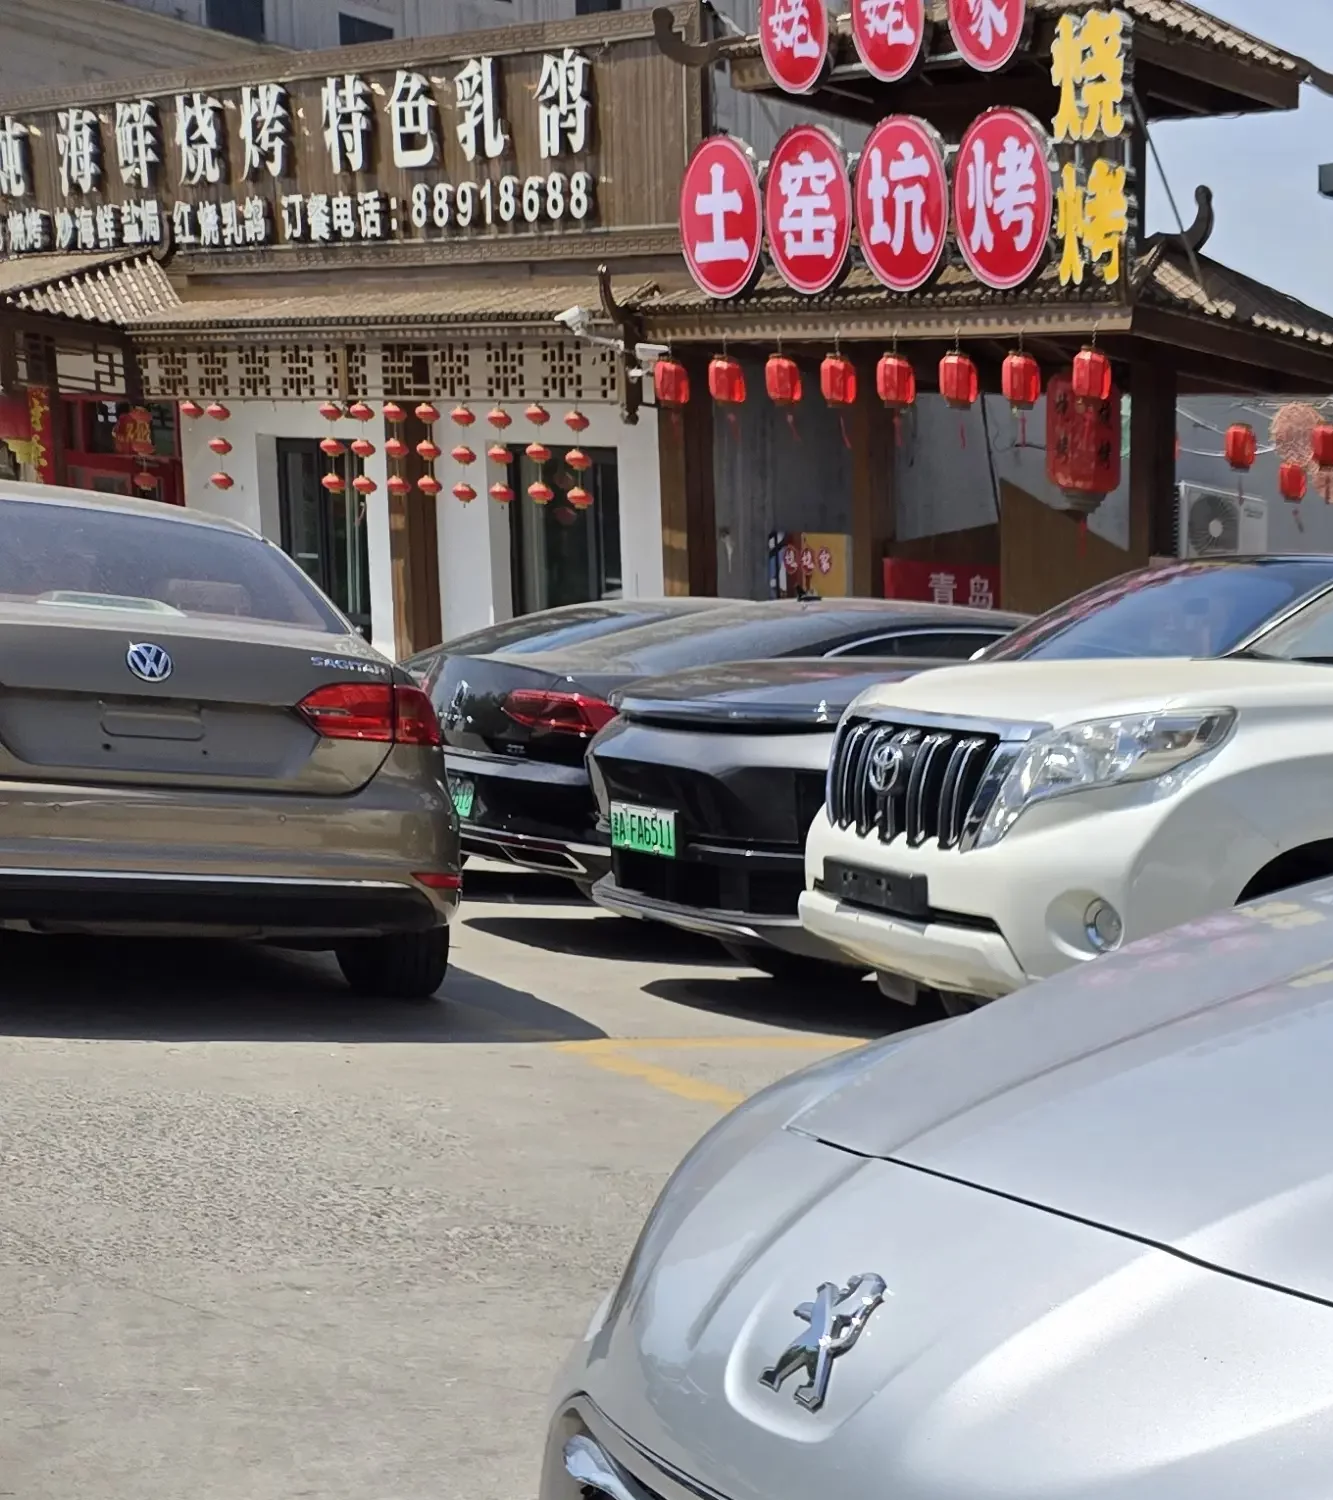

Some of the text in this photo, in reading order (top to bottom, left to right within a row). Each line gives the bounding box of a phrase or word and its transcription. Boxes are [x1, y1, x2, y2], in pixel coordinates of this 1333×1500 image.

[57, 83, 288, 196] 海鲜烧烤
[322, 48, 593, 173] 特色乳鸽
[1050, 8, 1128, 286] 烧烤
[411, 170, 591, 228] 88918688
[694, 136, 1037, 263] 土窑坑烤
[929, 572, 993, 609] 青岛
